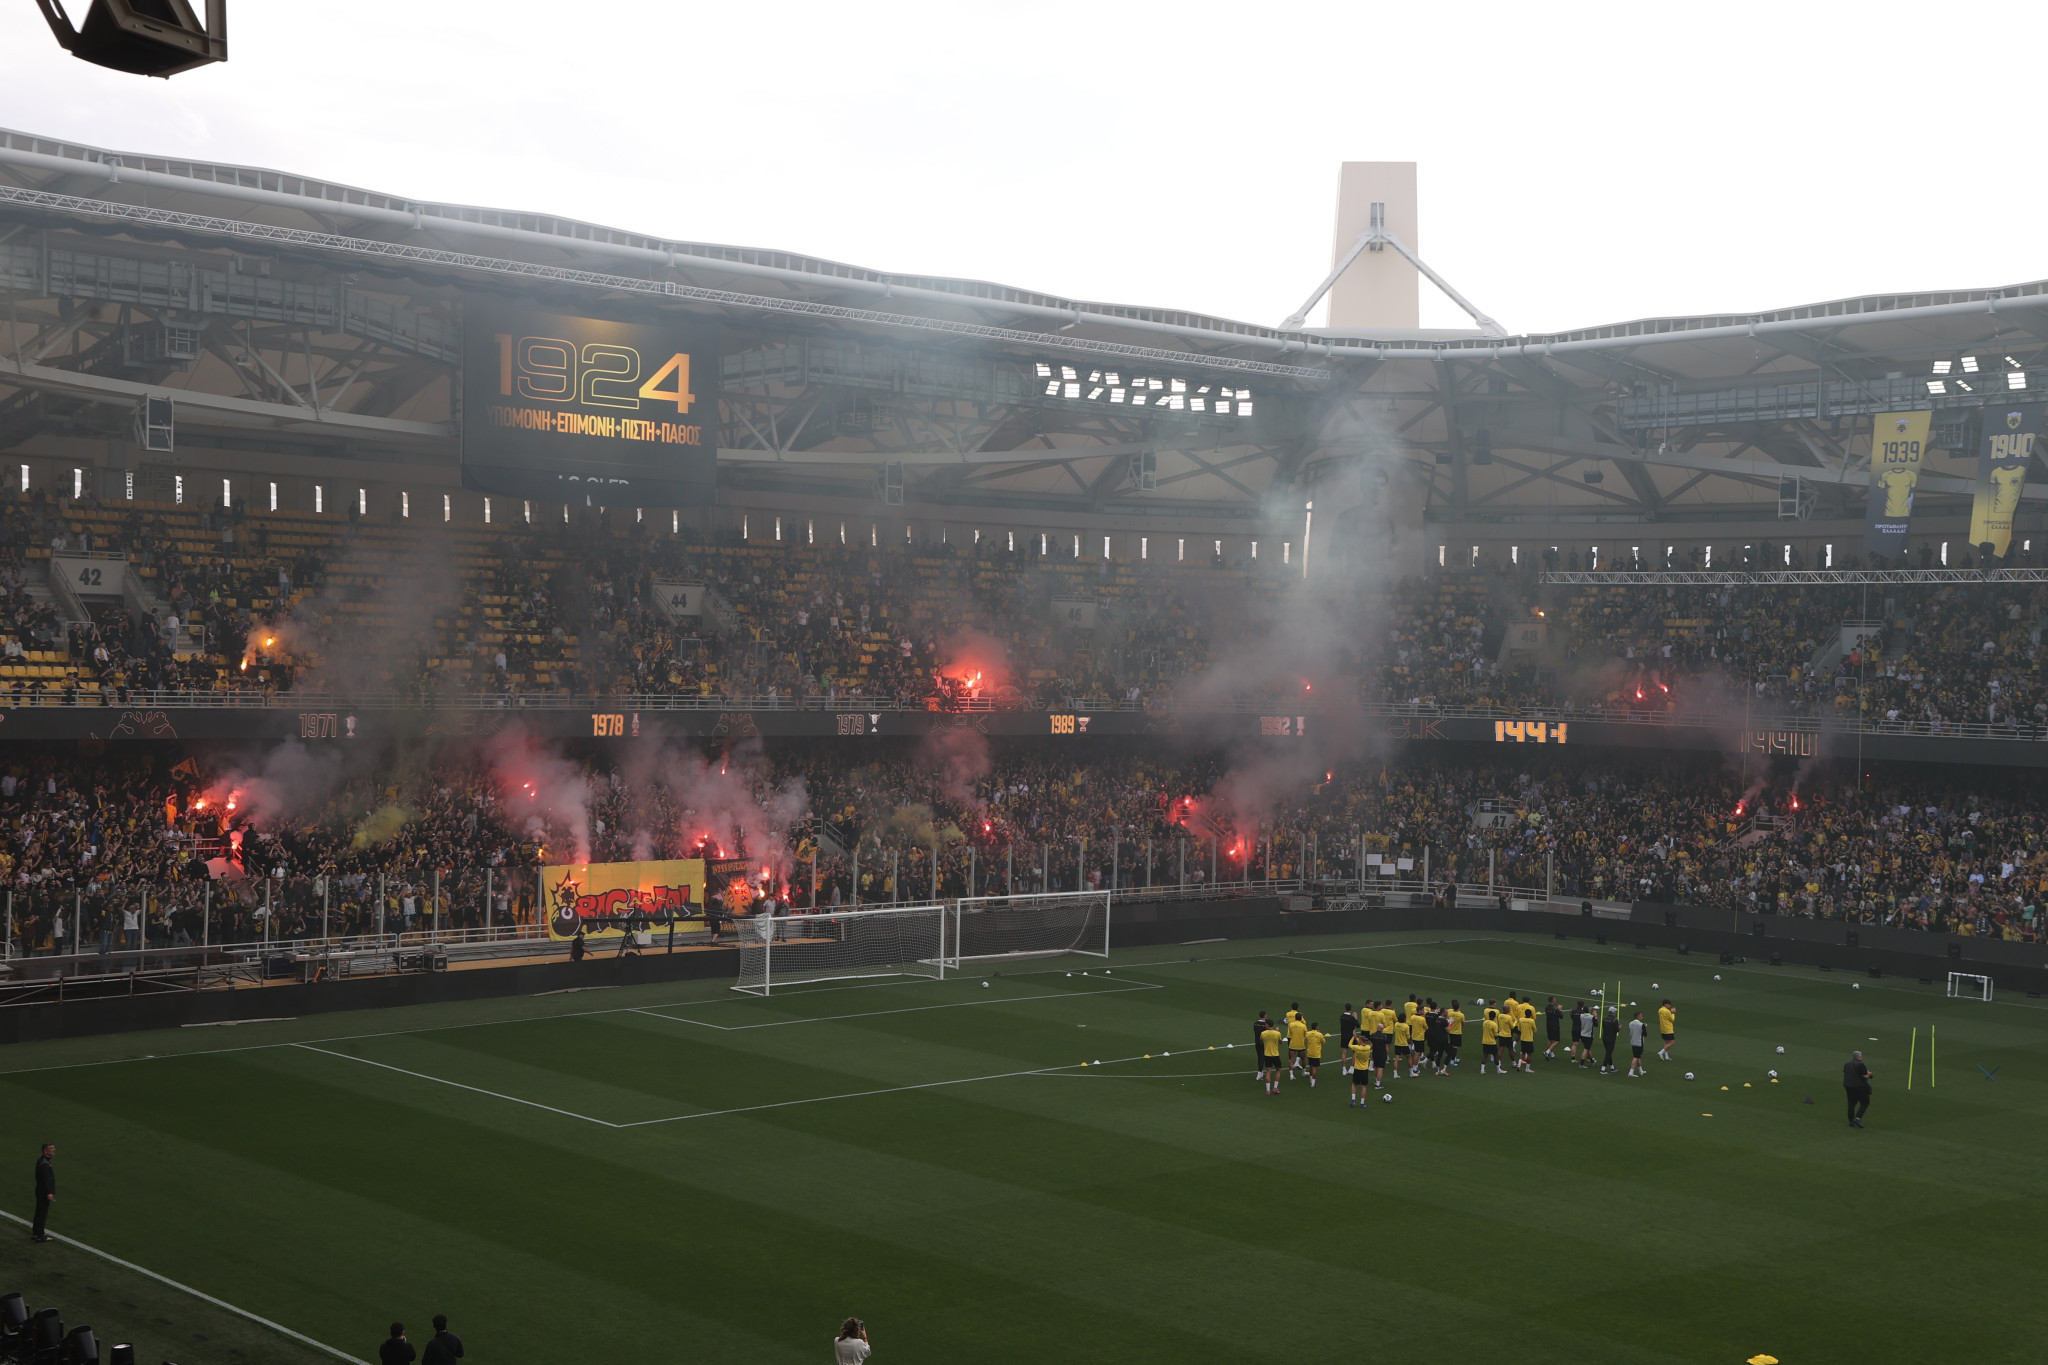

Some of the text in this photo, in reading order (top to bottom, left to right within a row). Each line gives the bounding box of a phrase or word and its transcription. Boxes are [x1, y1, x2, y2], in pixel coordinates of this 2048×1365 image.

[494, 333, 695, 413] 1924
[1882, 441, 1920, 463] 1939
[1989, 433, 2036, 459] 1940
[79, 568, 102, 586] 42
[671, 593, 687, 608] 44
[1068, 607, 1082, 622] 46
[1521, 629, 1538, 643] 48
[300, 713, 337, 738] 1971
[592, 714, 624, 736] 1978
[837, 714, 865, 735] 1979
[1050, 715, 1075, 734] 1989
[1260, 716, 1291, 736] 1992
[1492, 815, 1506, 828] 47
